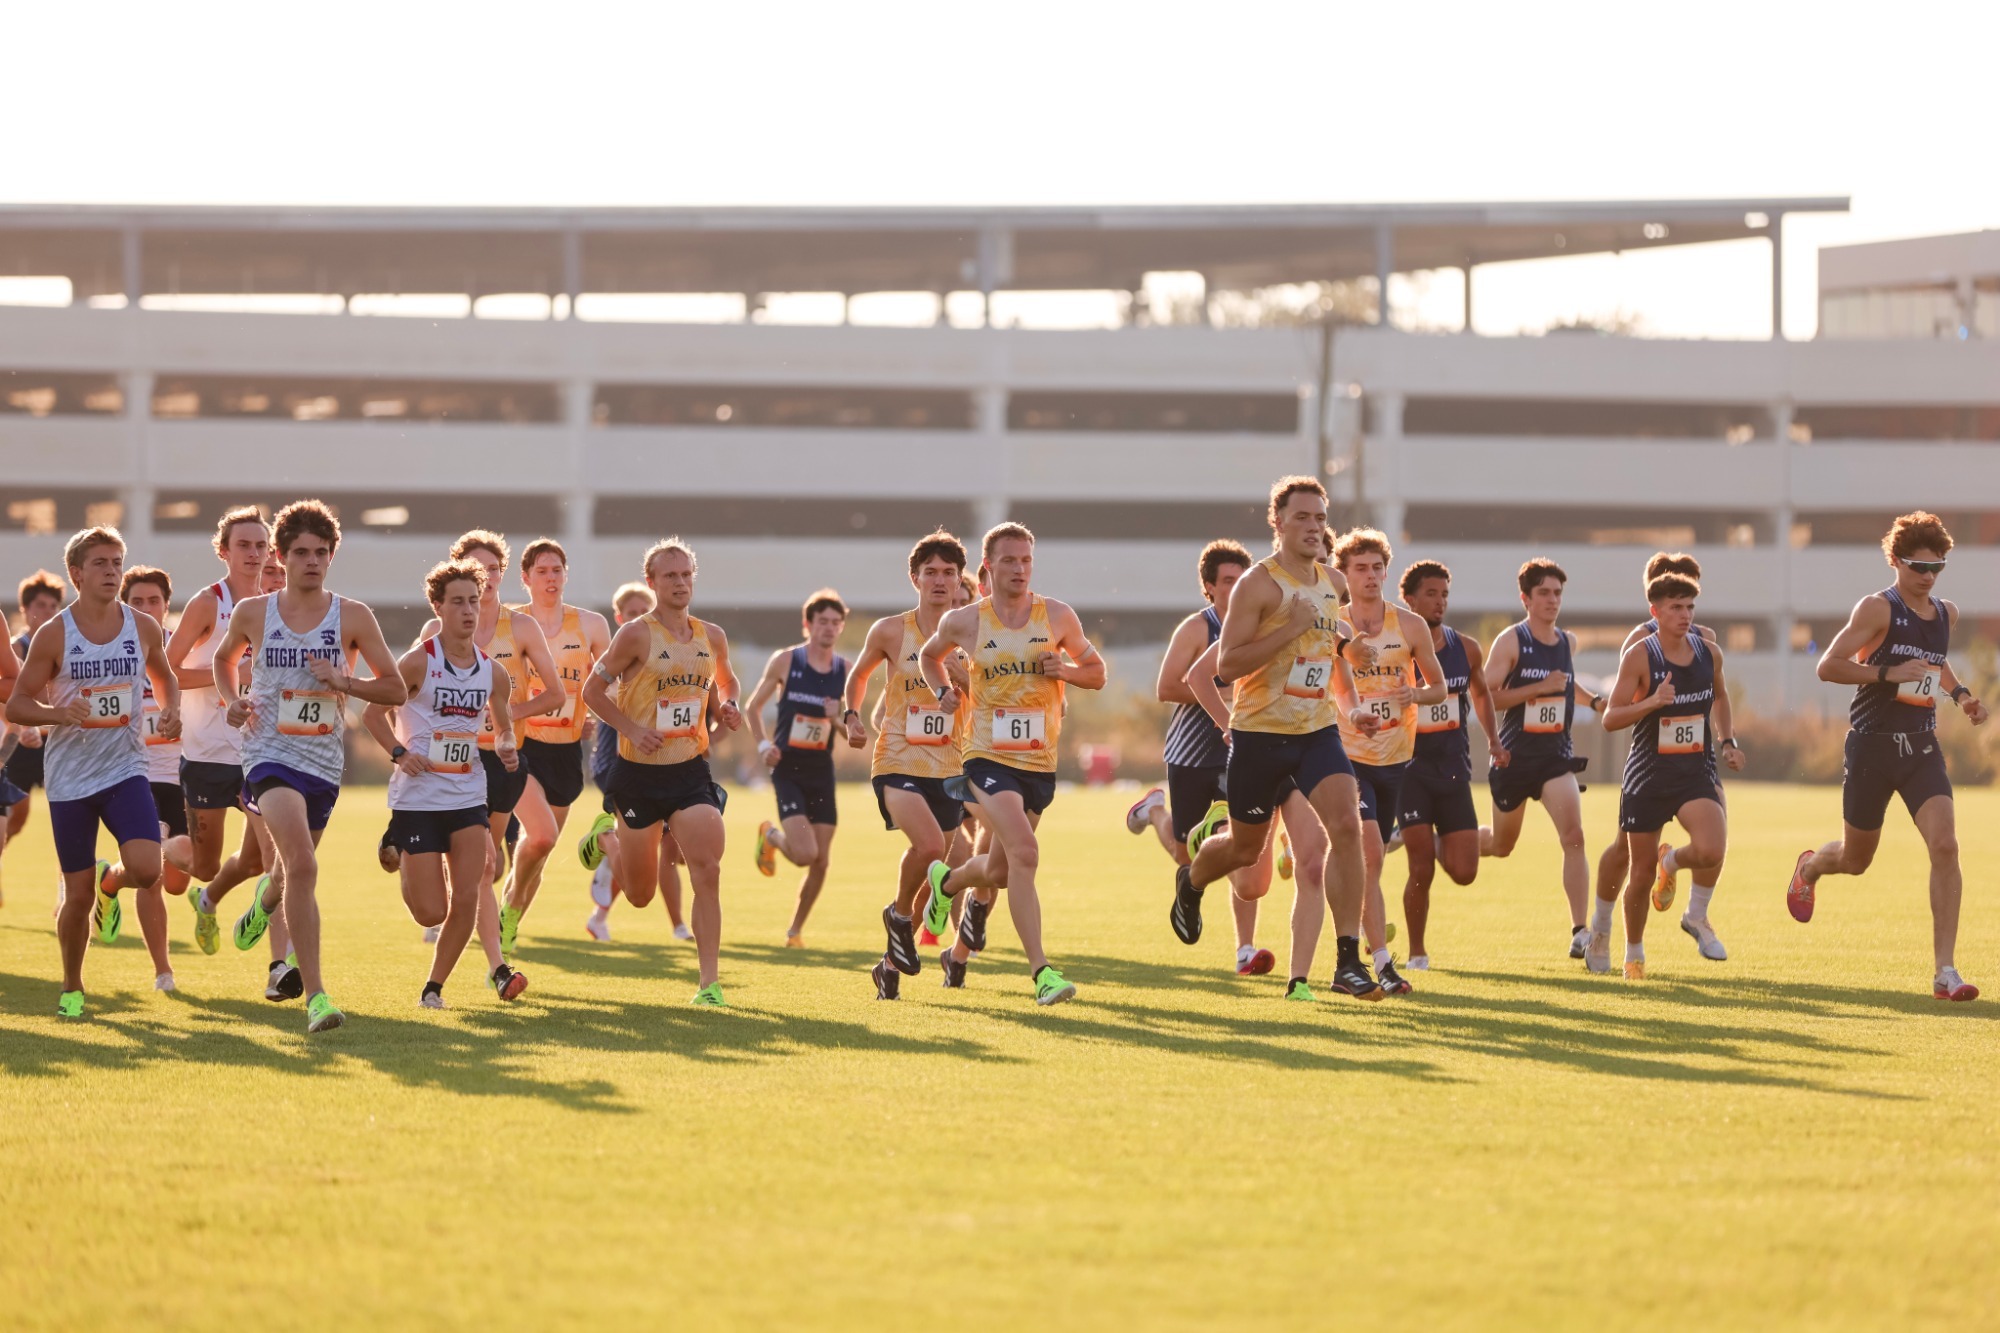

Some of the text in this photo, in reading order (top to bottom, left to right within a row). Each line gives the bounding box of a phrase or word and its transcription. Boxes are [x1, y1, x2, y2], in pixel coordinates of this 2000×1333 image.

[266, 647, 298, 668] HIGH
[70, 657, 139, 680] HIGH POINT
[984, 661, 1044, 681] LASALL
[1305, 667, 1323, 687] 62
[1352, 665, 1403, 680] ASALLE
[99, 696, 120, 716] 39
[433, 687, 486, 711] RMU
[298, 703, 320, 723] 43
[673, 707, 691, 727] 54
[1371, 702, 1390, 720] 55
[1431, 704, 1449, 722] 88
[1540, 706, 1556, 723] 86
[923, 715, 944, 735] 60
[1011, 719, 1030, 739] 61
[1675, 726, 1693, 743] 85
[443, 743, 470, 763] 150
